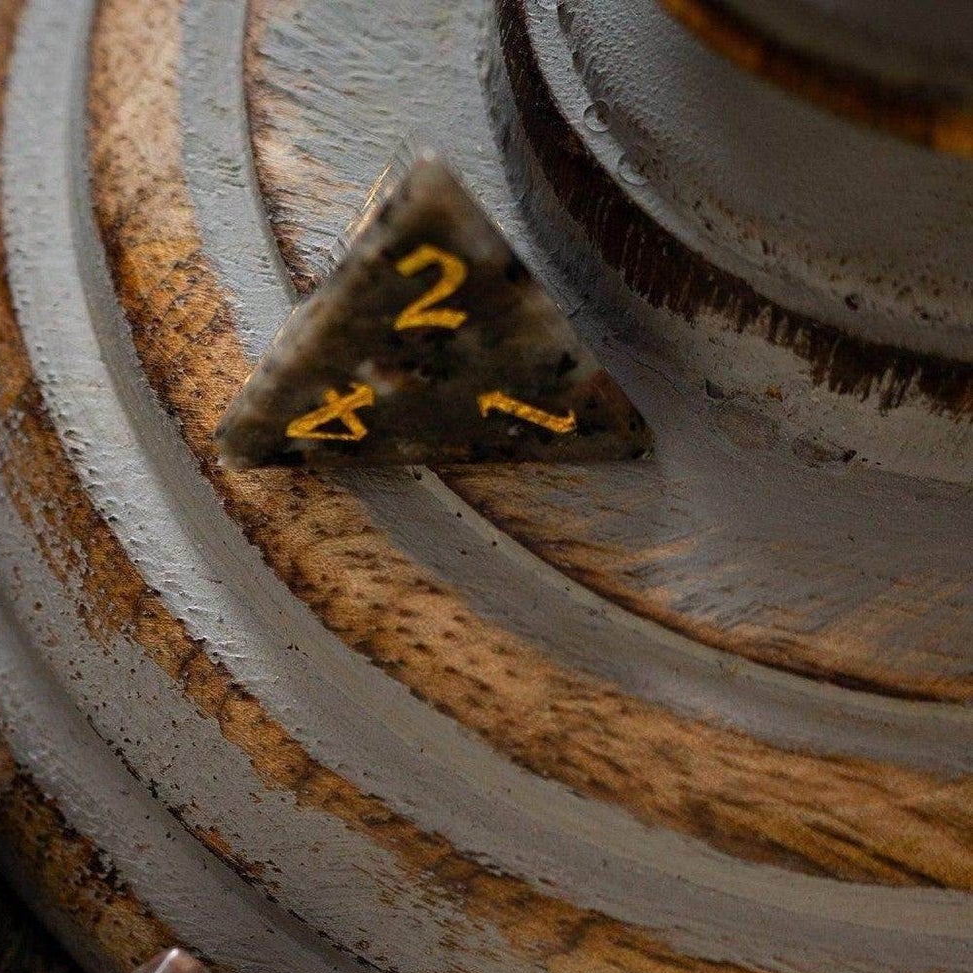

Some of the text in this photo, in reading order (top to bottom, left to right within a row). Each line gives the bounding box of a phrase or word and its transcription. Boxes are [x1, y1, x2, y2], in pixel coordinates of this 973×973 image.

[393, 244, 469, 332] 2
[285, 382, 377, 443] 4
[476, 390, 578, 435] 1
